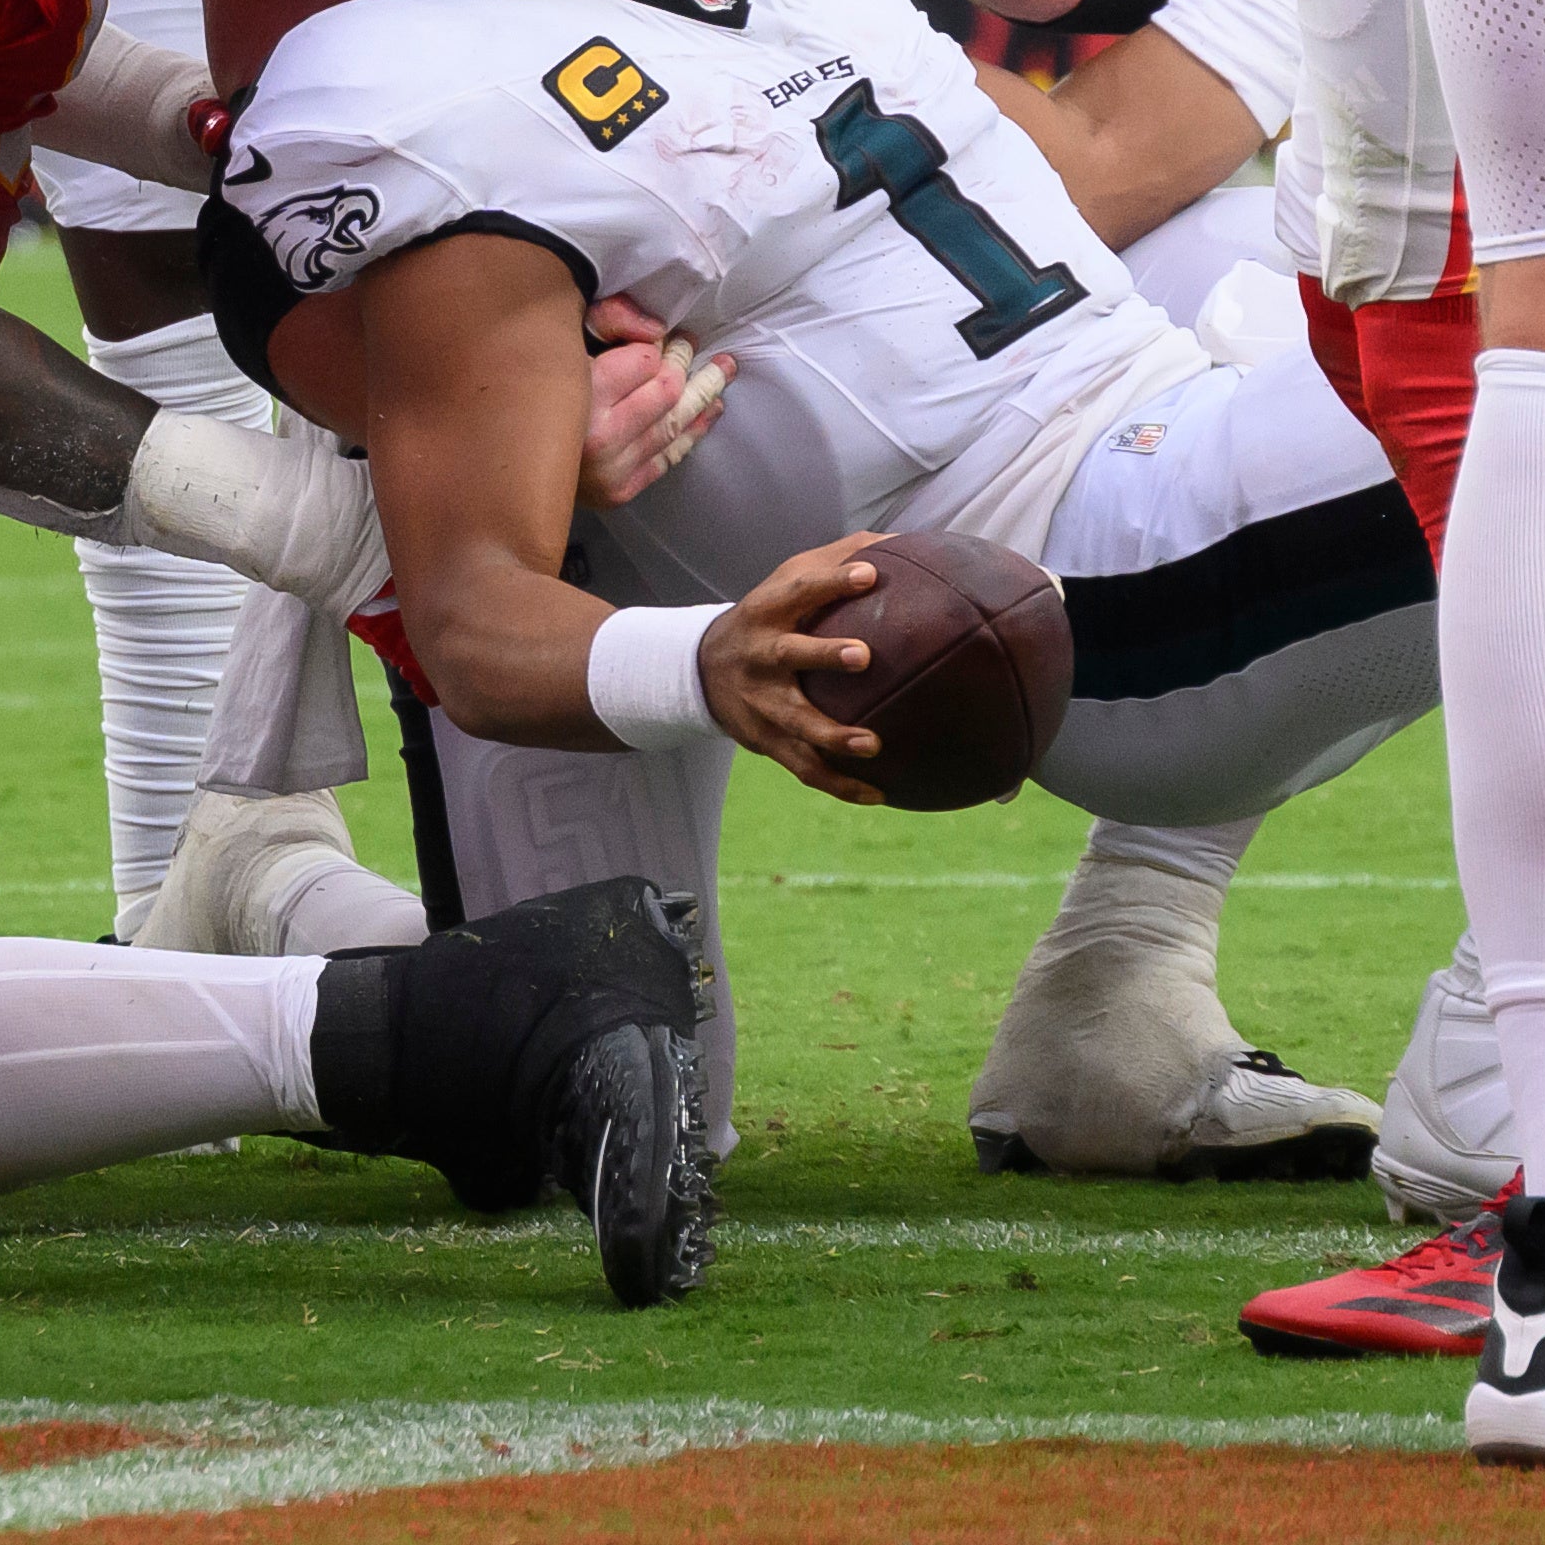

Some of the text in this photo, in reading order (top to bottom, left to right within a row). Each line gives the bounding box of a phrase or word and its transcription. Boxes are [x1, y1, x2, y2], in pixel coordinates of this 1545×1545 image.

[557, 45, 643, 122] C
[762, 55, 856, 109] EAGLES
[811, 77, 1090, 361] 1
